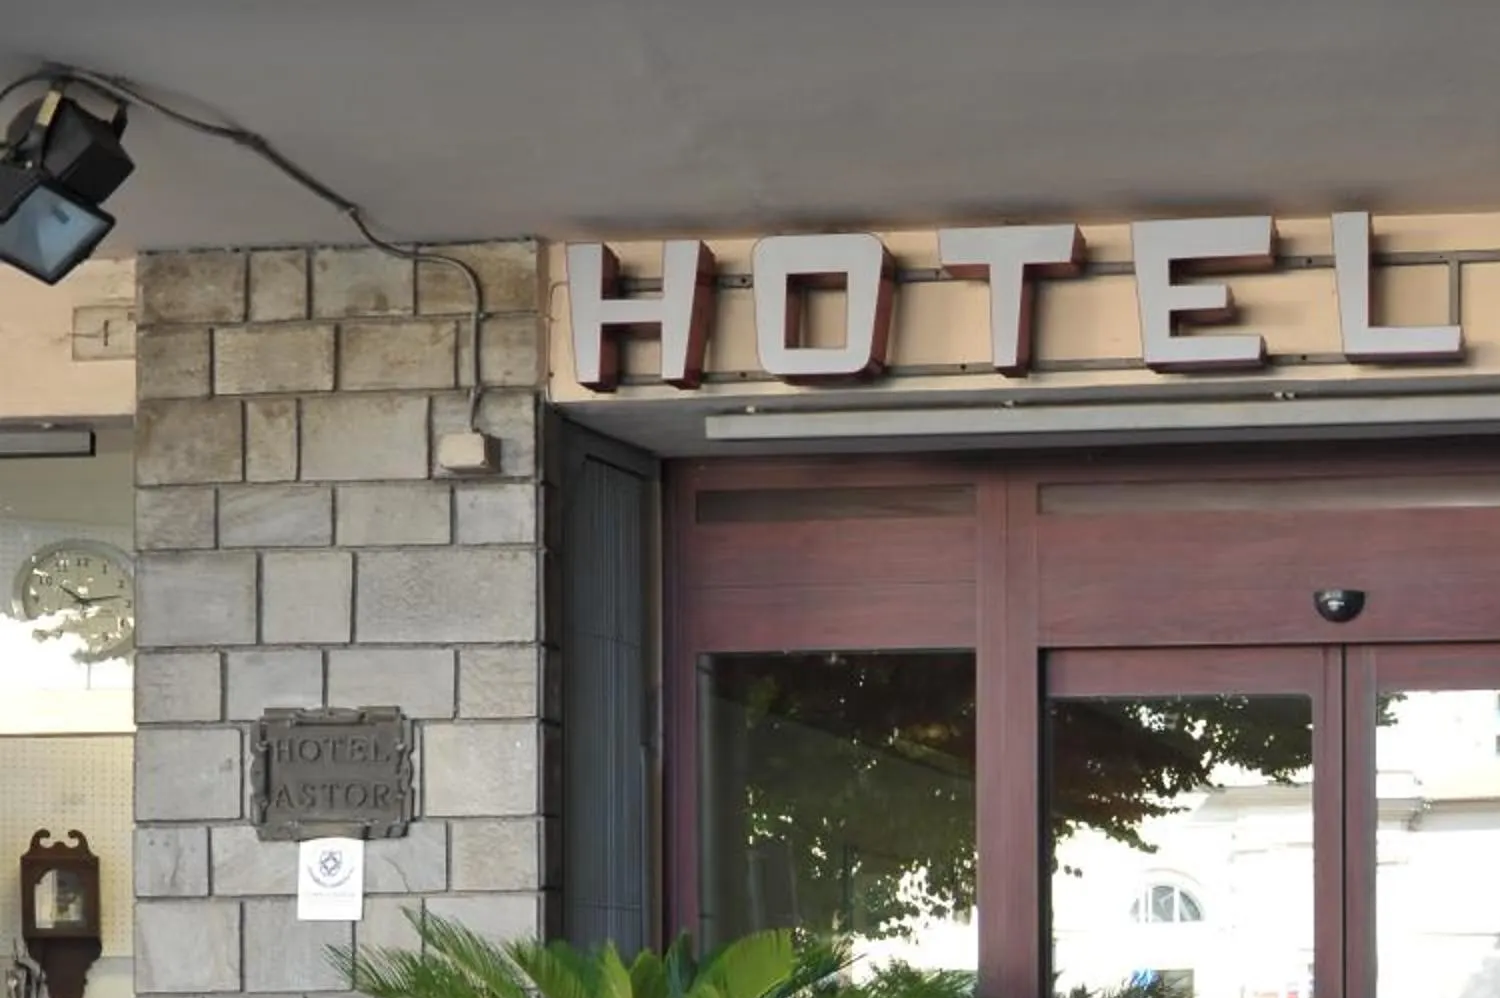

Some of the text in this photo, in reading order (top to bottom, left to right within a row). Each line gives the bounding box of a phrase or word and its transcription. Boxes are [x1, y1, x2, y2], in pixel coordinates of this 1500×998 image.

[564, 211, 1464, 393] HOTEL
[275, 737, 391, 764] HOTEL
[275, 782, 392, 812] ASTOR
